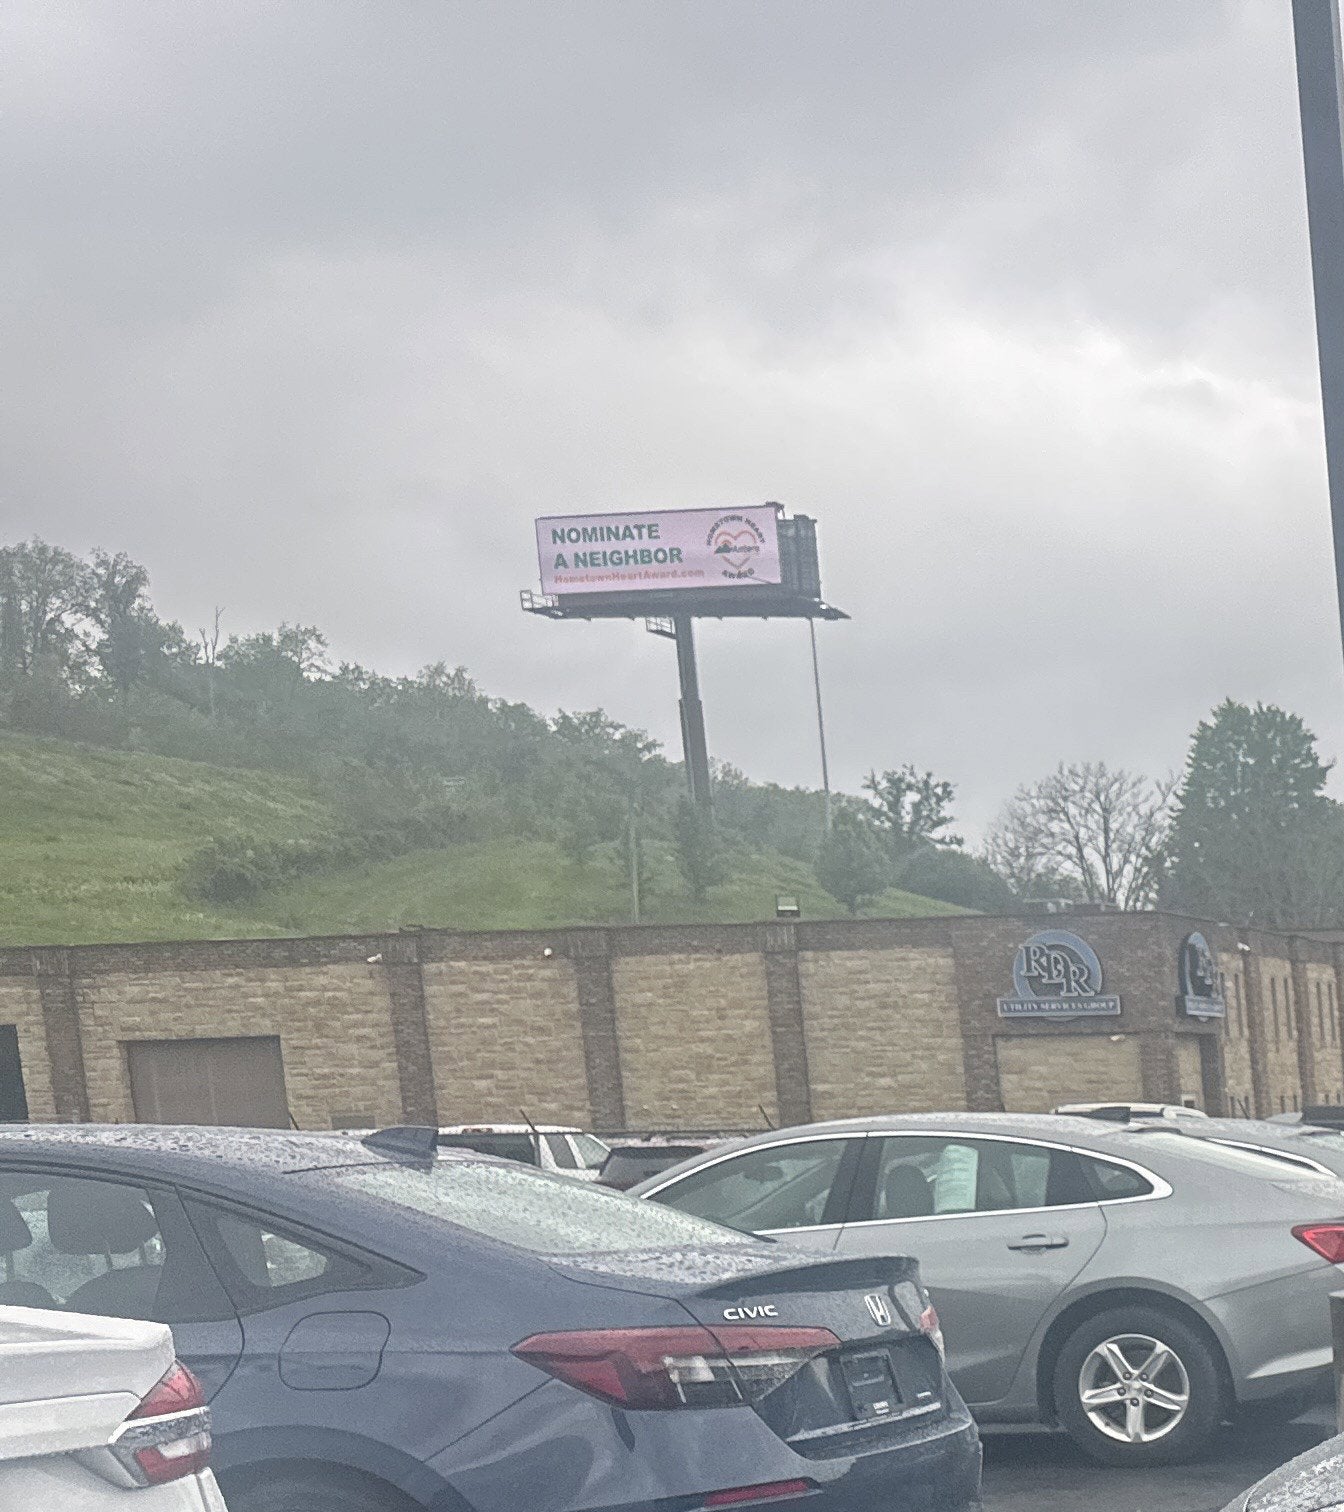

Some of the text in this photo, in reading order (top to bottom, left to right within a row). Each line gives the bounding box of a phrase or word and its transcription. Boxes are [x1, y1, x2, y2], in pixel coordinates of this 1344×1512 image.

[551, 523, 660, 544] NOMINATE
[553, 547, 683, 570] A NEIGHBOR
[723, 1304, 778, 1321] CIVIC
